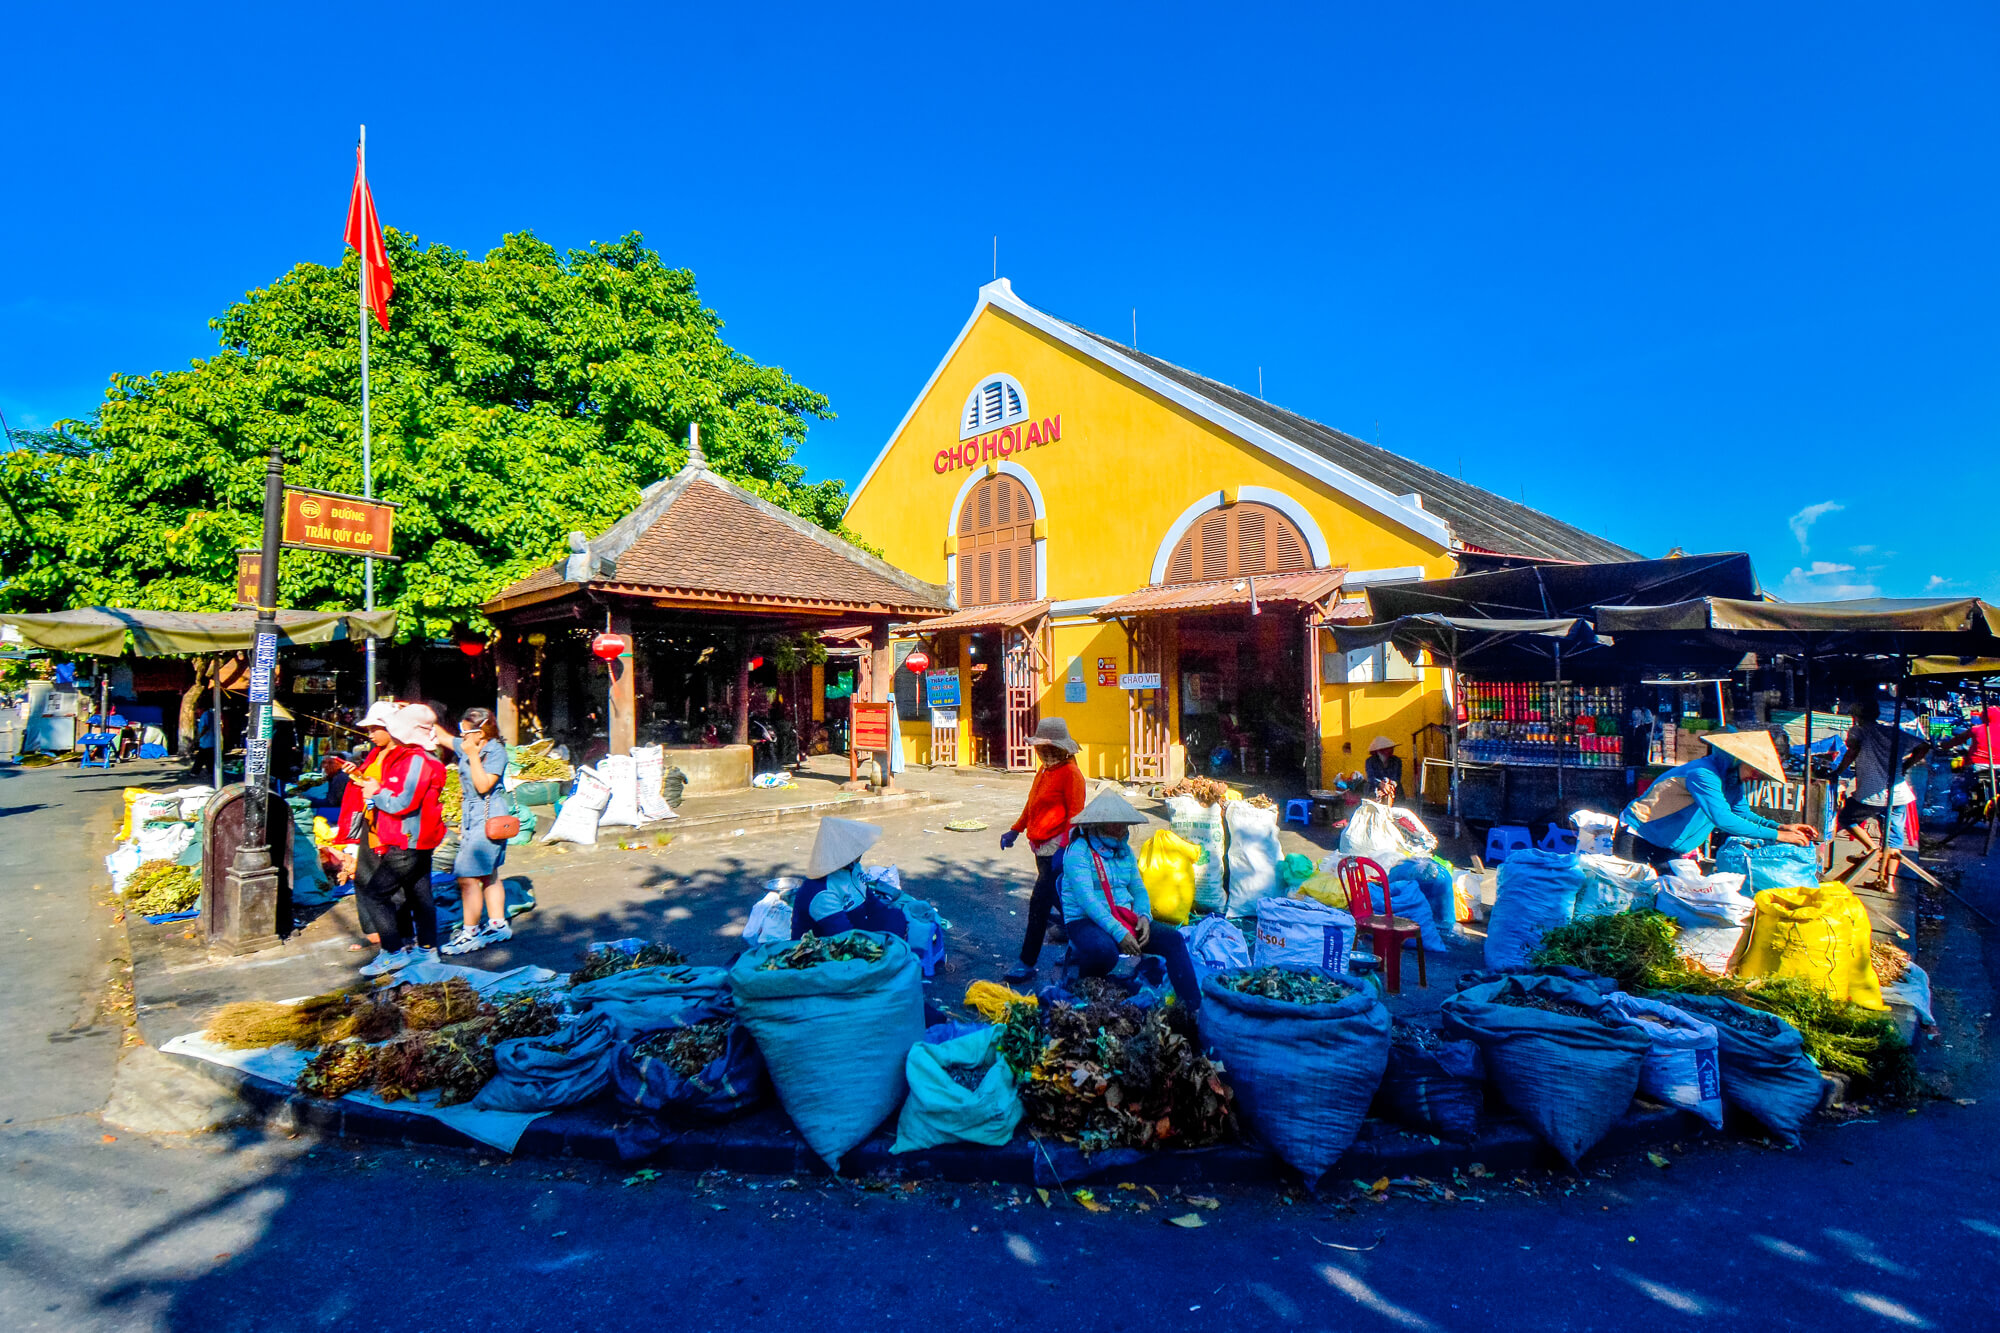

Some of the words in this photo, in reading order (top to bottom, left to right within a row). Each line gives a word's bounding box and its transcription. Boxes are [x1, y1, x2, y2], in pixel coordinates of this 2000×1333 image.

[934, 436, 979, 474] CHỢ
[982, 426, 1021, 461] HỘI
[1024, 414, 1061, 450] AN
[331, 507, 365, 522] ĐƯỜNG
[304, 522, 331, 540] TRẦN
[354, 531, 373, 545] CÁP
